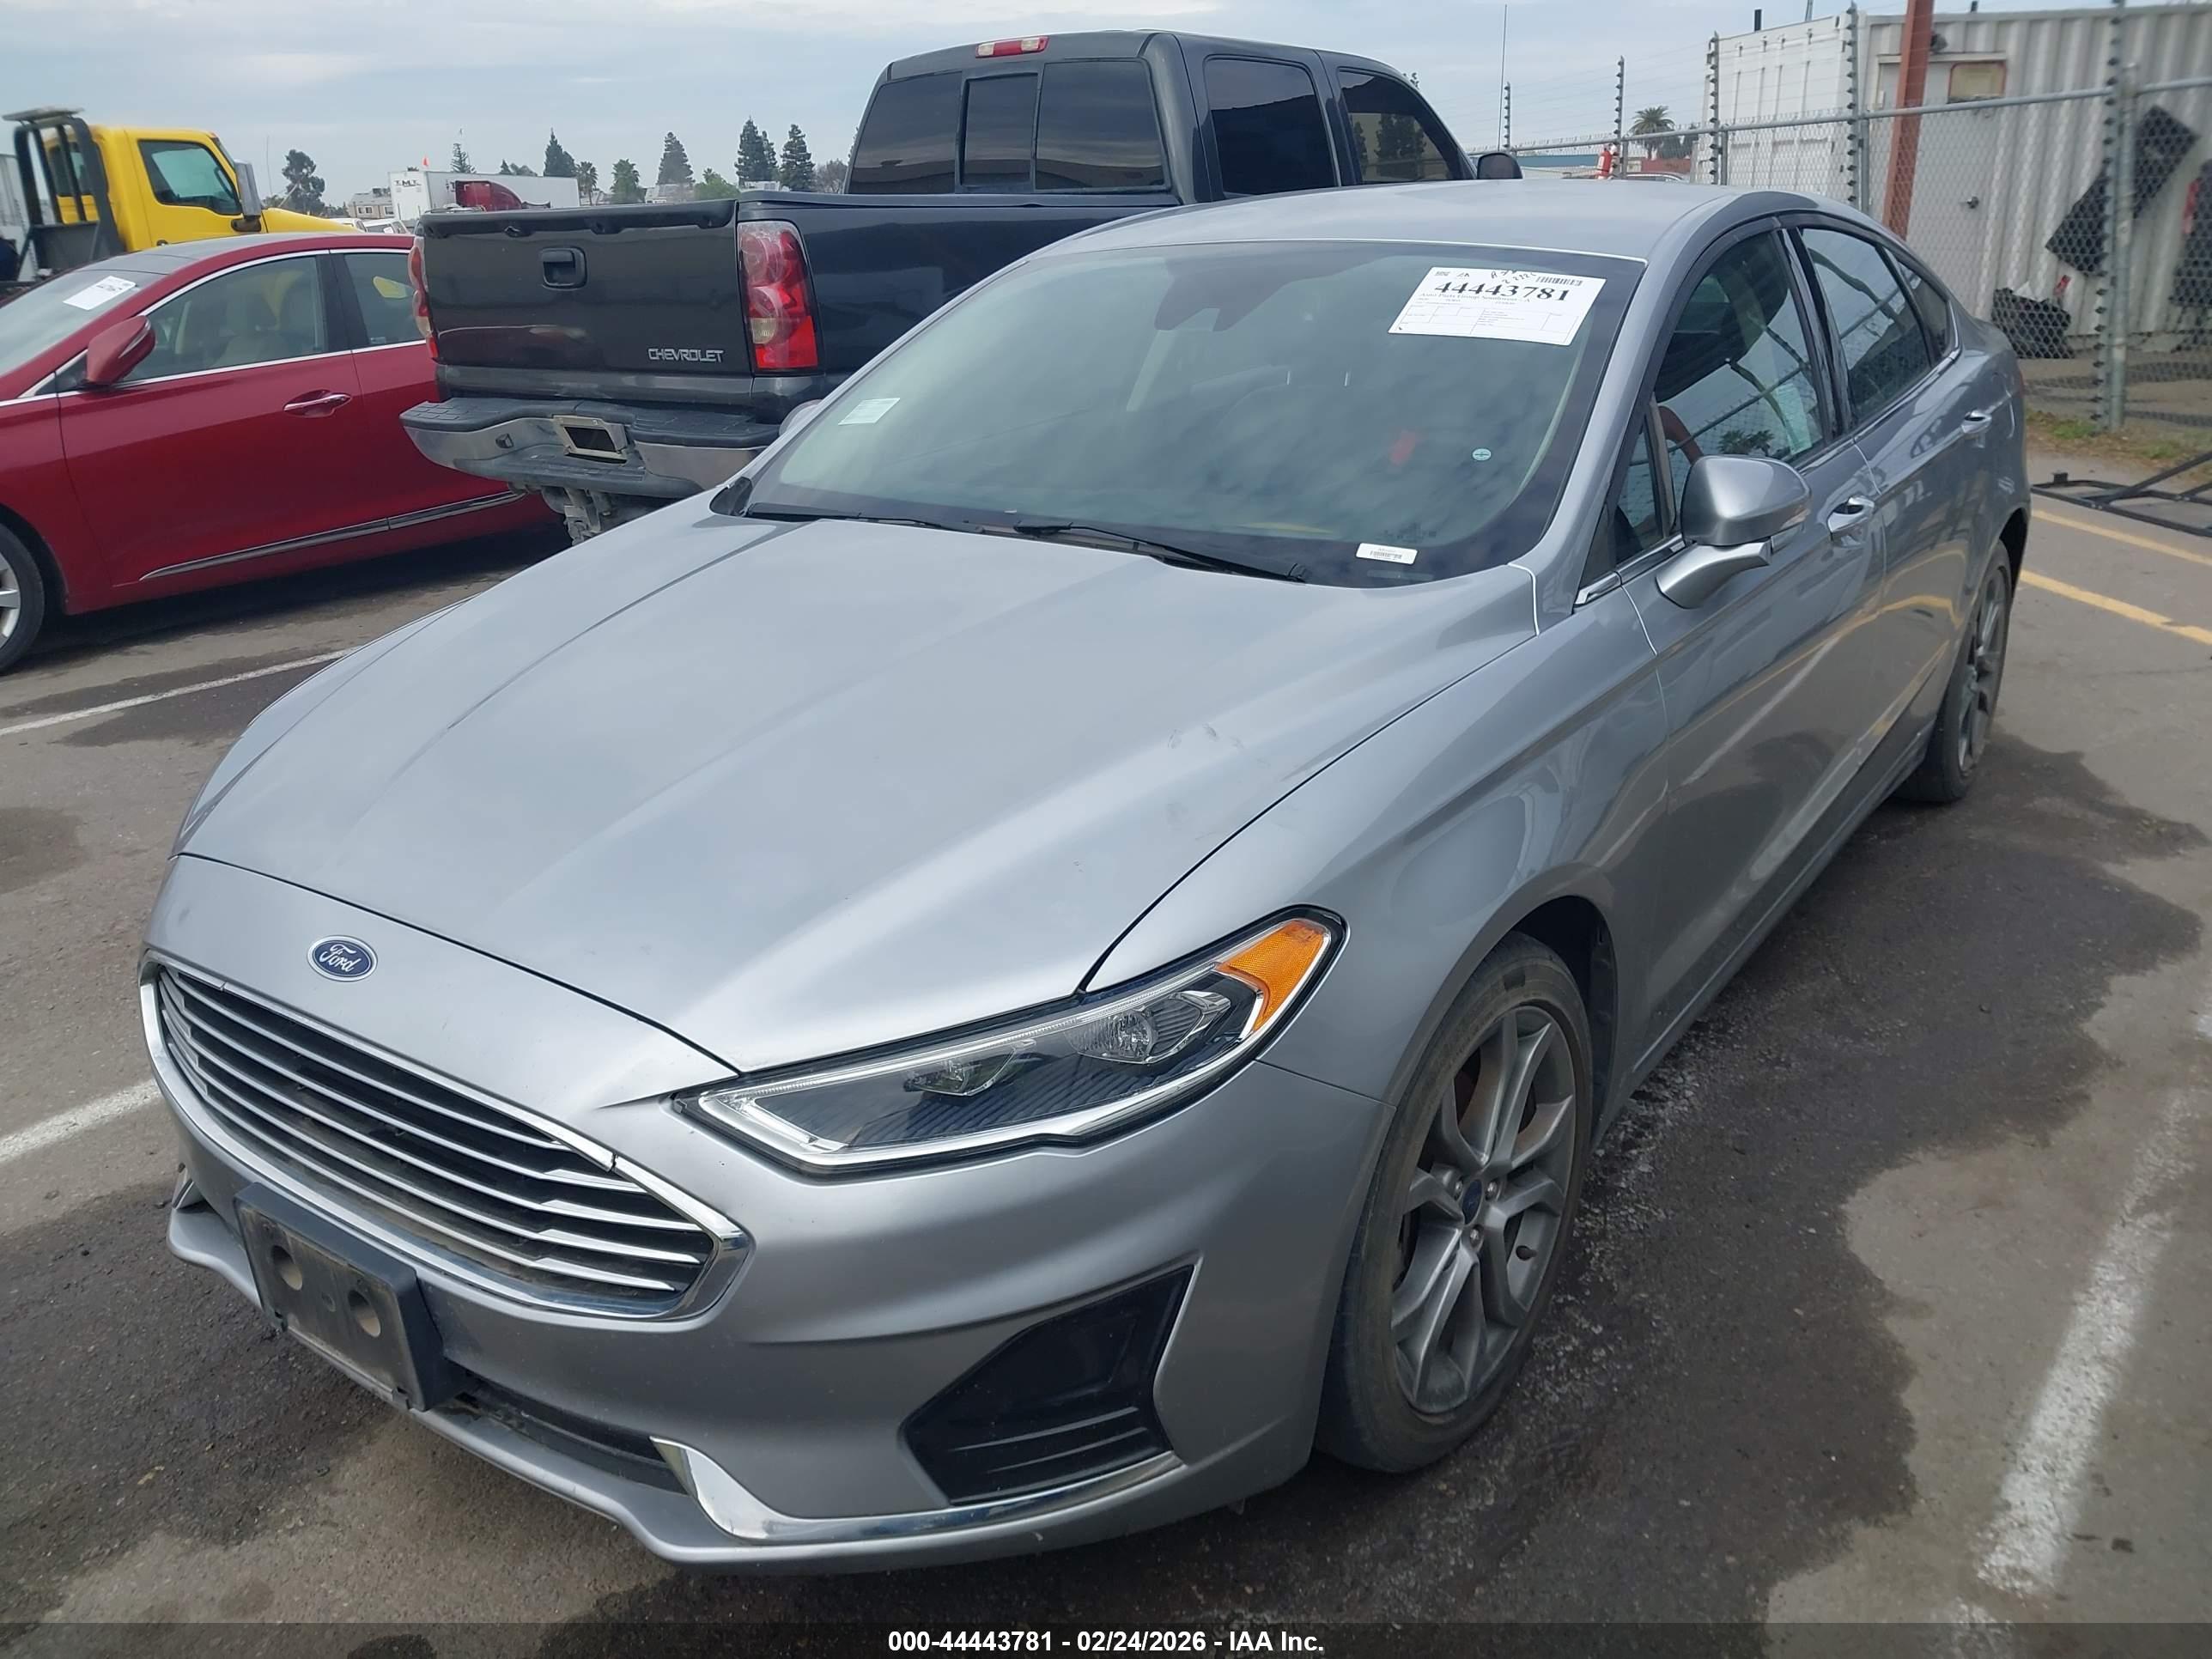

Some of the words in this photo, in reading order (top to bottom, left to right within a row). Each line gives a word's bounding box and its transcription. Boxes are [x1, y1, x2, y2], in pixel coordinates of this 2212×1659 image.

[1434, 282, 1571, 301] 44443781
[647, 348, 724, 362] CHEVROLET
[319, 944, 362, 972] Ford
